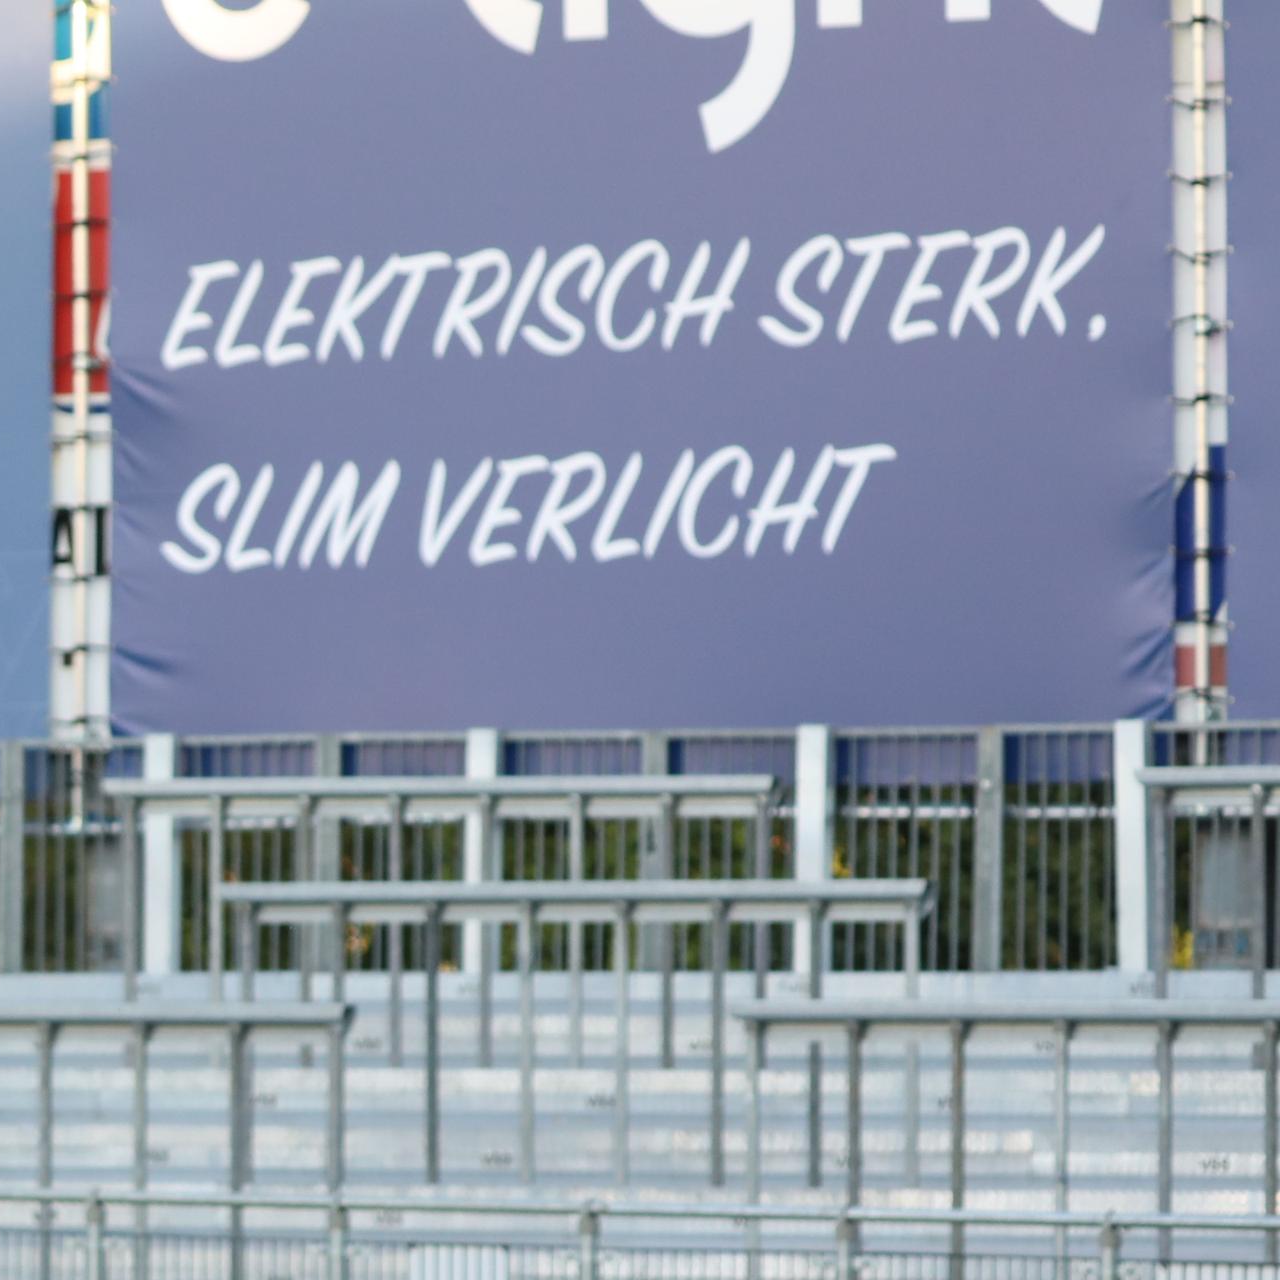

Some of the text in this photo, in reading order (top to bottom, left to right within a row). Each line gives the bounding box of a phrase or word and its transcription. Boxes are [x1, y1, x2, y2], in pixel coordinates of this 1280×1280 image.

[161, 225, 1106, 370] ELEKTRISCH STERK.
[160, 445, 897, 573] SLIM VERLICHT
